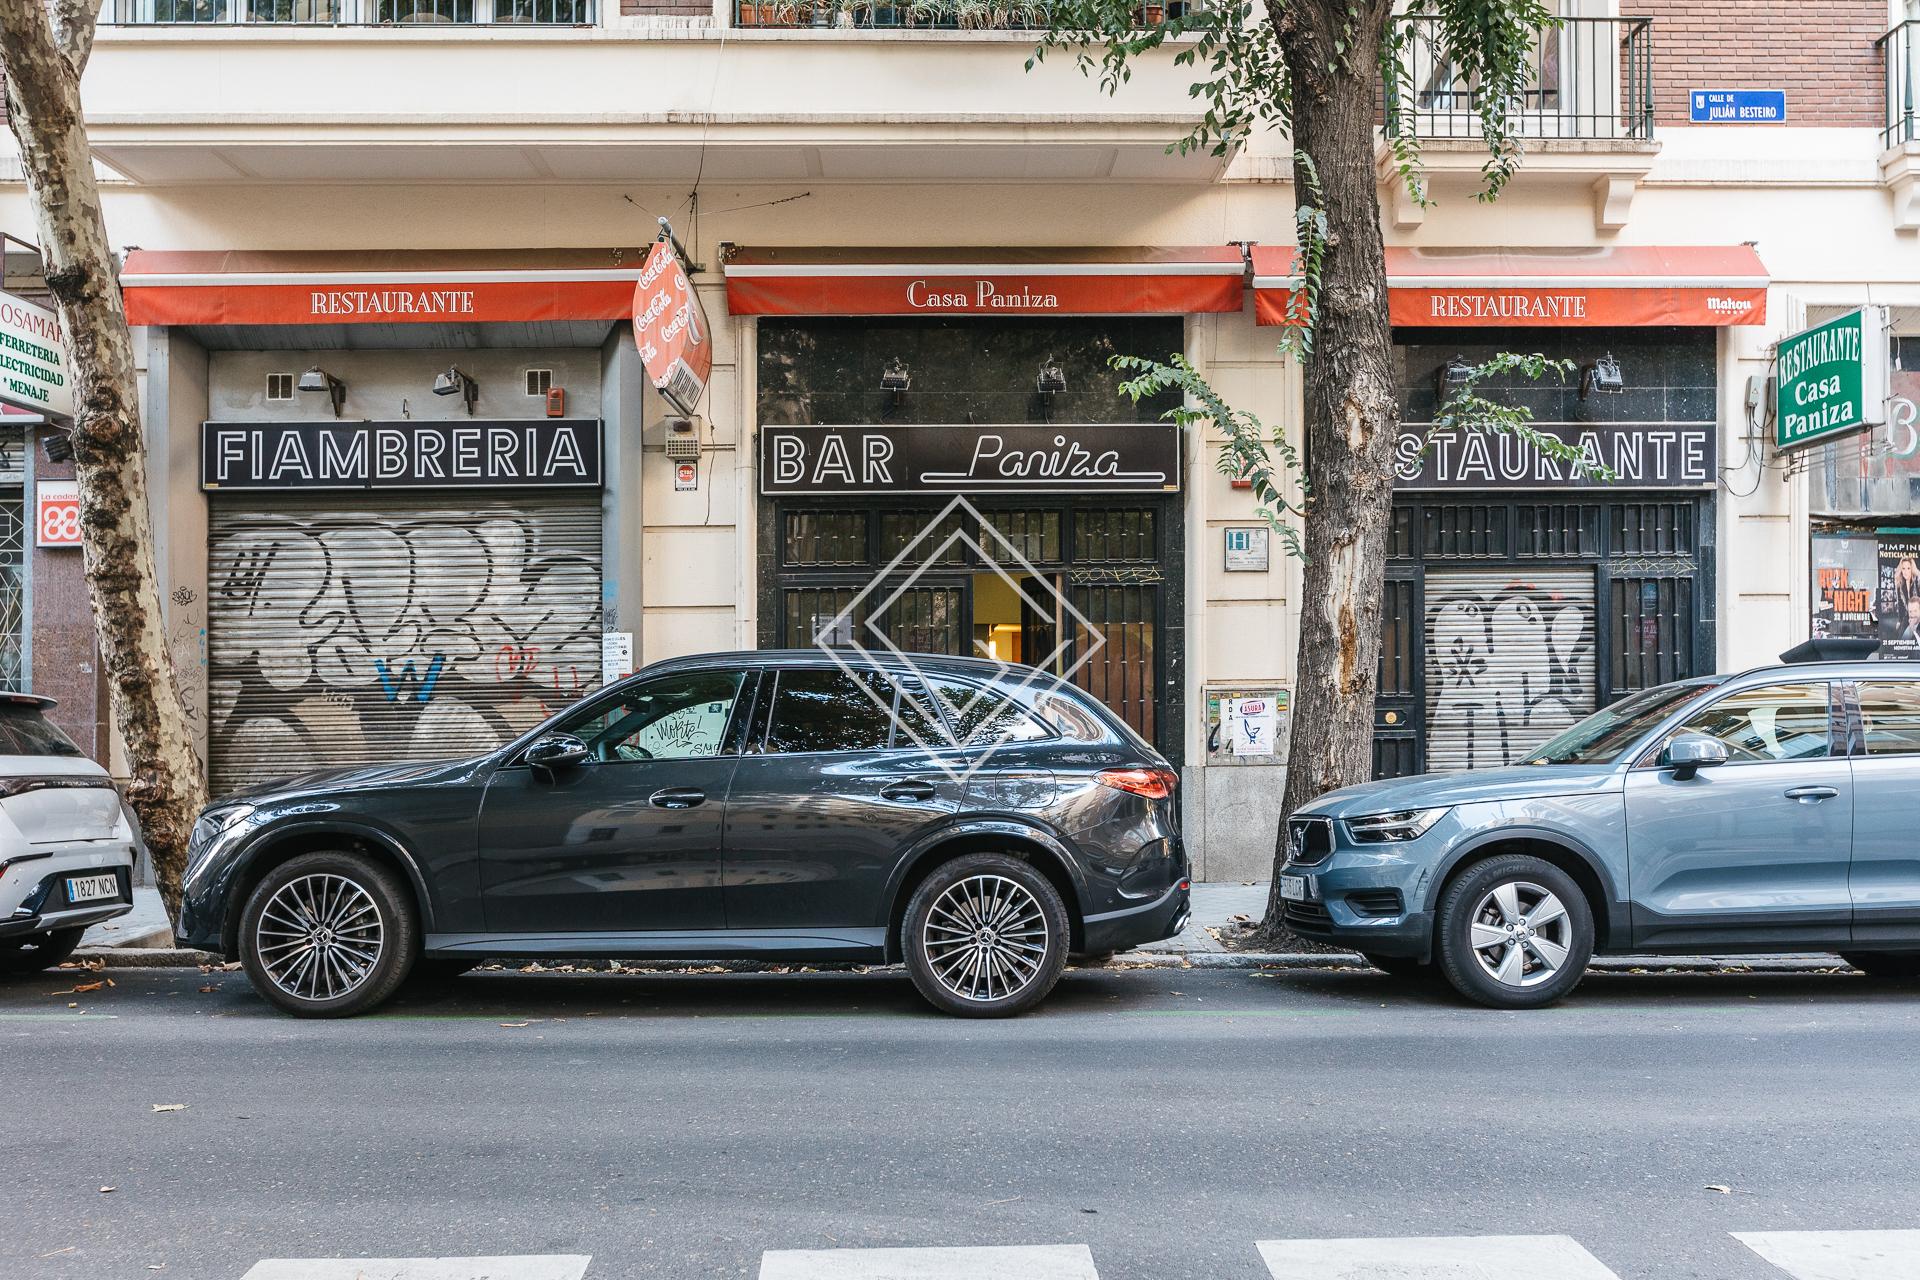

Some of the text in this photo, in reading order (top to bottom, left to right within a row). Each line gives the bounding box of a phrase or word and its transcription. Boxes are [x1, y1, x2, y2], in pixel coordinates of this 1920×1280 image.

[1709, 94, 1734, 102] CALLE DE
[1709, 104, 1777, 120] JULIÁN BESTEIRO
[311, 291, 474, 314] RESTAURANTE
[906, 280, 1059, 308] Casa Paniza
[1706, 297, 1752, 310] Mahou
[1430, 295, 1586, 318] RESTAURANTE
[1779, 327, 1860, 389] RESTAURANTE
[9, 378, 50, 402] MENAJE
[1794, 374, 1842, 406] Casa
[1784, 400, 1854, 439] Paniza
[216, 427, 587, 480] FIAMBRERIA
[772, 434, 1140, 484] BAR Paniza
[1834, 590, 1871, 612] NIGHT
[75, 877, 116, 898] 1827 NCN
